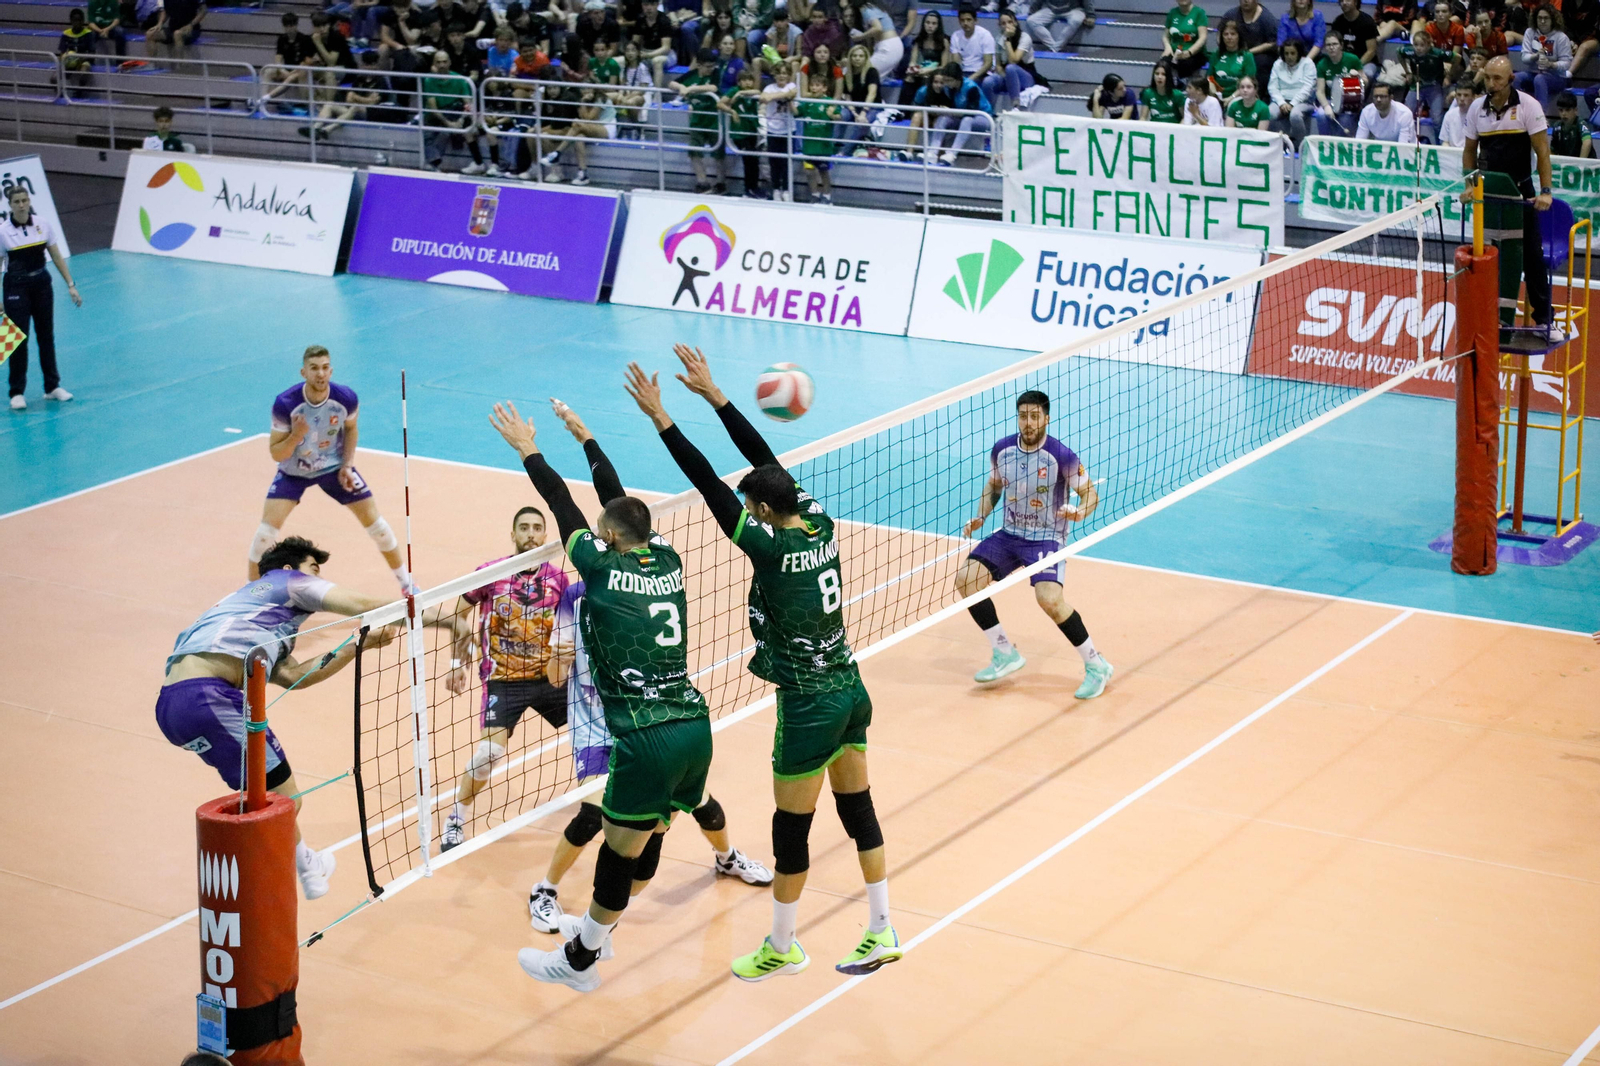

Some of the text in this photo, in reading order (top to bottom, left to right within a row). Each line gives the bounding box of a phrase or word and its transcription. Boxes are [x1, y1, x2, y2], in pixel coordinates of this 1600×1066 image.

[213, 177, 318, 223] Andalucía
[391, 237, 560, 272] DIPUTACIÓN DE ALMERÍA
[741, 249, 870, 283] COSTA DE
[1036, 250, 1234, 303] Fundación
[705, 281, 862, 327] ALMERÍA
[1031, 288, 1170, 344] Unicaja
[1297, 287, 1456, 352] SVM
[1289, 344, 1363, 370] SUPERLIGA
[818, 568, 841, 614] 8
[648, 602, 682, 647] 3
[201, 906, 241, 1009] MON
